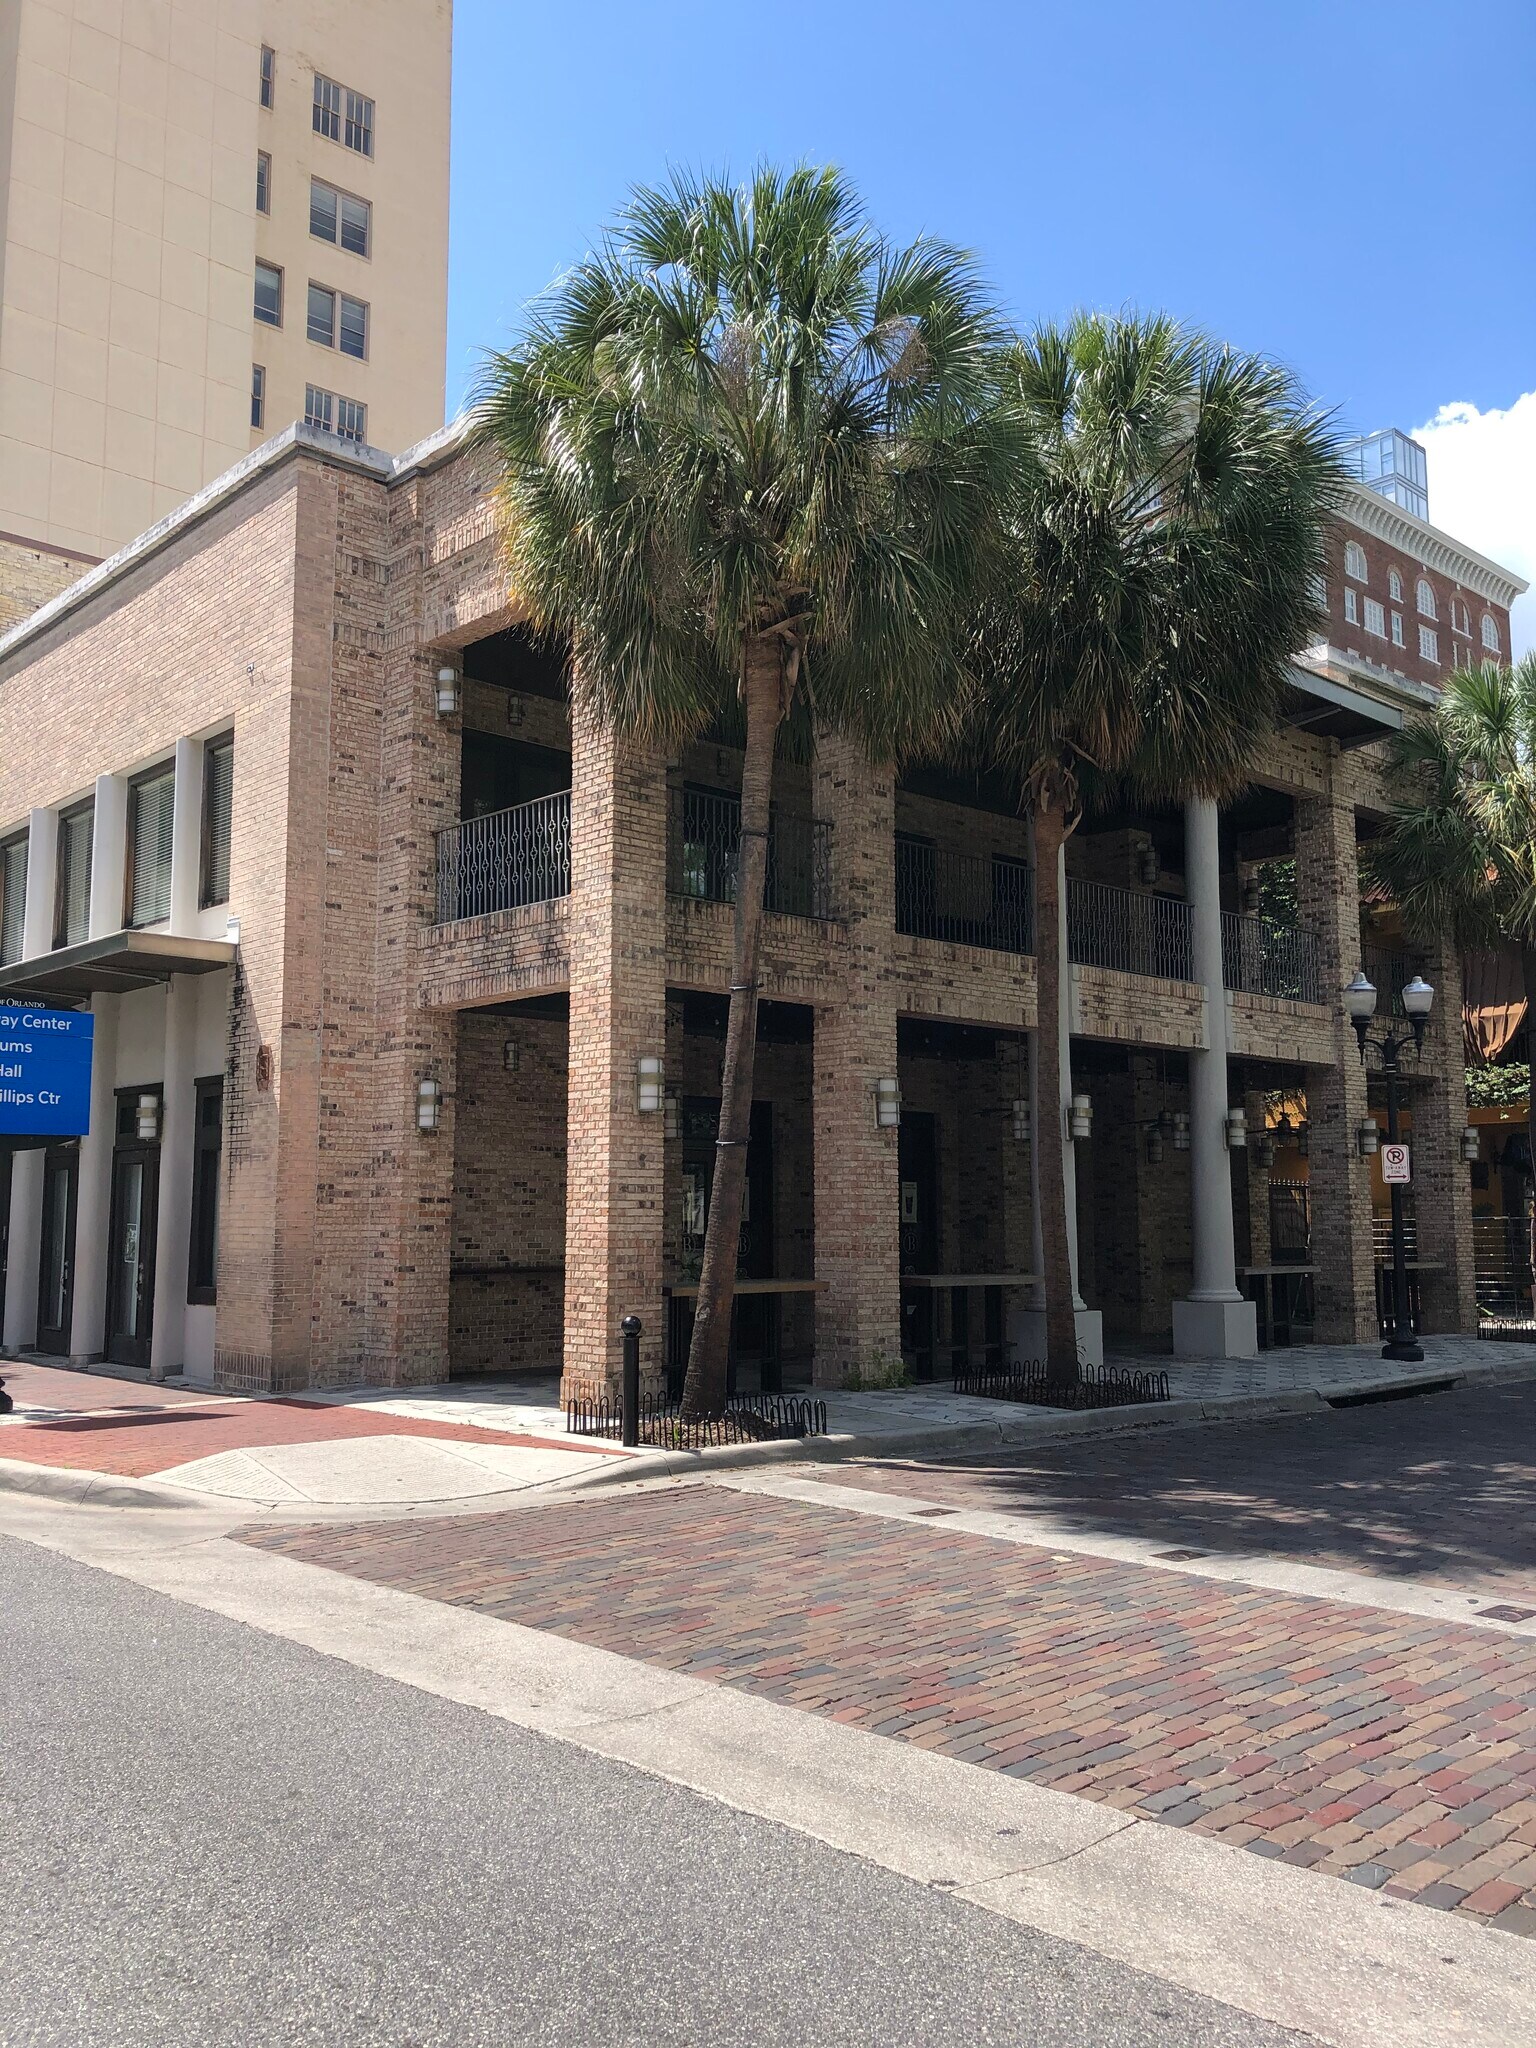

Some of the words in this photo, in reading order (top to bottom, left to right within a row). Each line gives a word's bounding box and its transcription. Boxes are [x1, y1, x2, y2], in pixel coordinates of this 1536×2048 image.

[6, 997, 46, 1009] ORLANDO
[0, 1015, 19, 1030] ay
[22, 1014, 72, 1031] Center
[38, 1090, 61, 1105] Ctr
